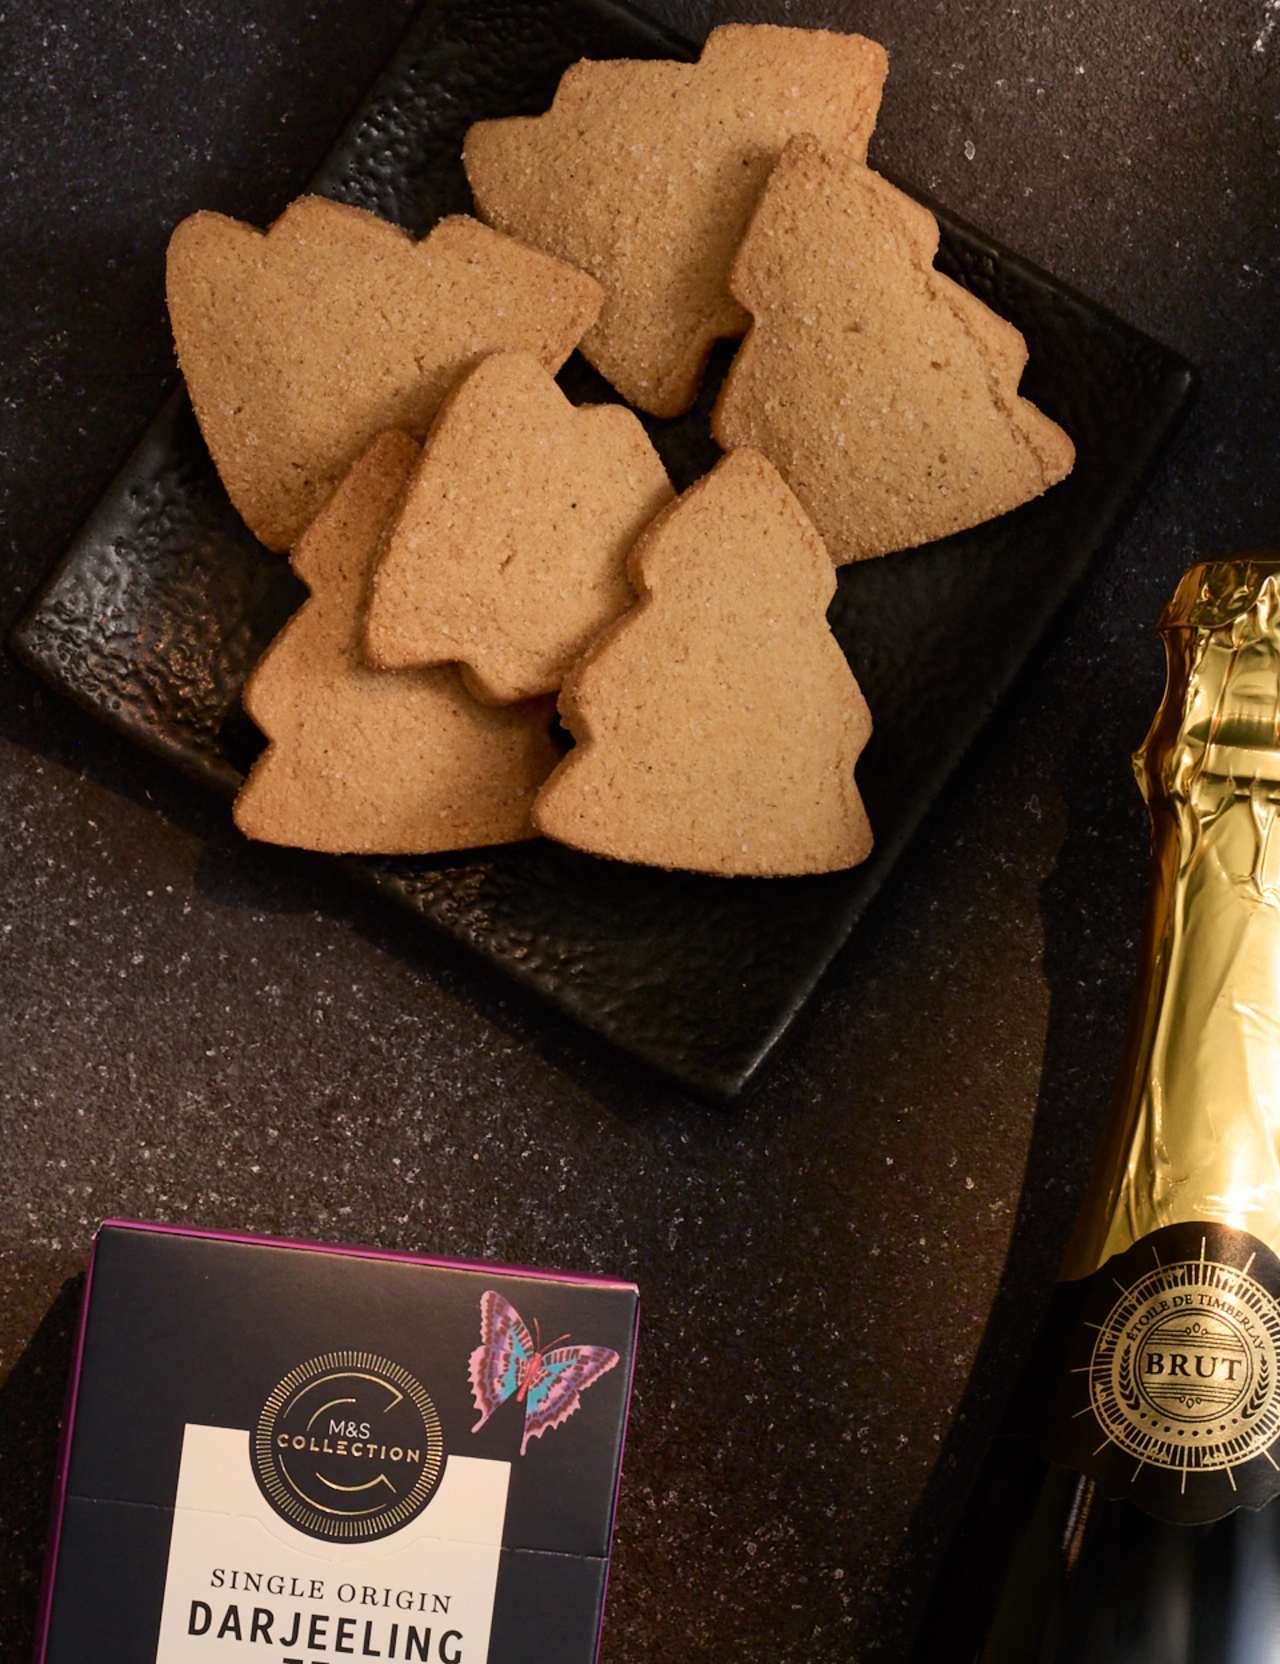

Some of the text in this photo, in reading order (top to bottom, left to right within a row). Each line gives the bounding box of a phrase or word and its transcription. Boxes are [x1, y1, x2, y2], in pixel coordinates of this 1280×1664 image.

[1172, 1294, 1193, 1308] DE
[1198, 1293, 1265, 1350] TIMBERLAY
[1144, 1352, 1242, 1381] BRUT
[328, 1419, 370, 1440] M&S
[277, 1434, 421, 1463] COLLECTION
[210, 1568, 452, 1615] SINGLE ORIGIN
